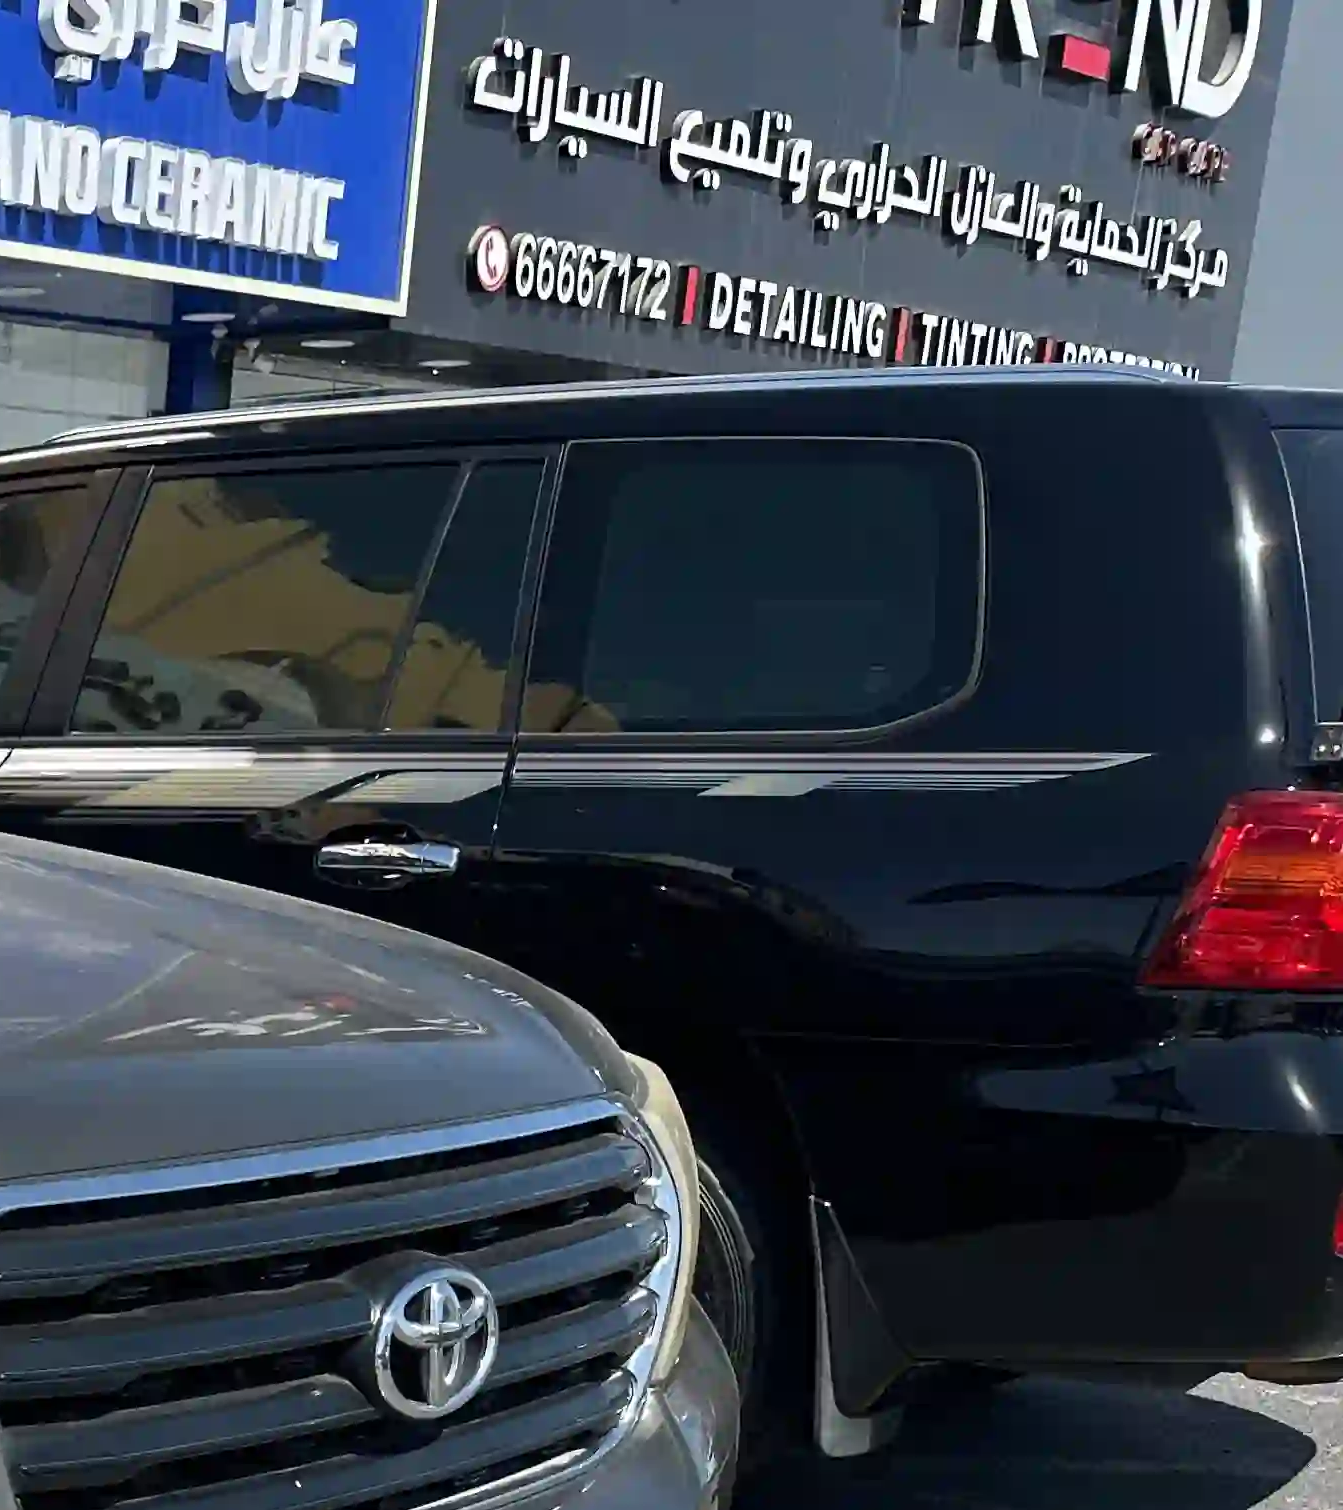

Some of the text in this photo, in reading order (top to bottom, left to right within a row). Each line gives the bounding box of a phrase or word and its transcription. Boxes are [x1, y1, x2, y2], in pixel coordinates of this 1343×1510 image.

[470, 37, 1228, 297] مركز الحماية والعازل الحراري وتلميع السيارات
[512, 232, 672, 321] 66667172
[709, 271, 888, 358] DETAILING
[920, 312, 1035, 367] TINTING
